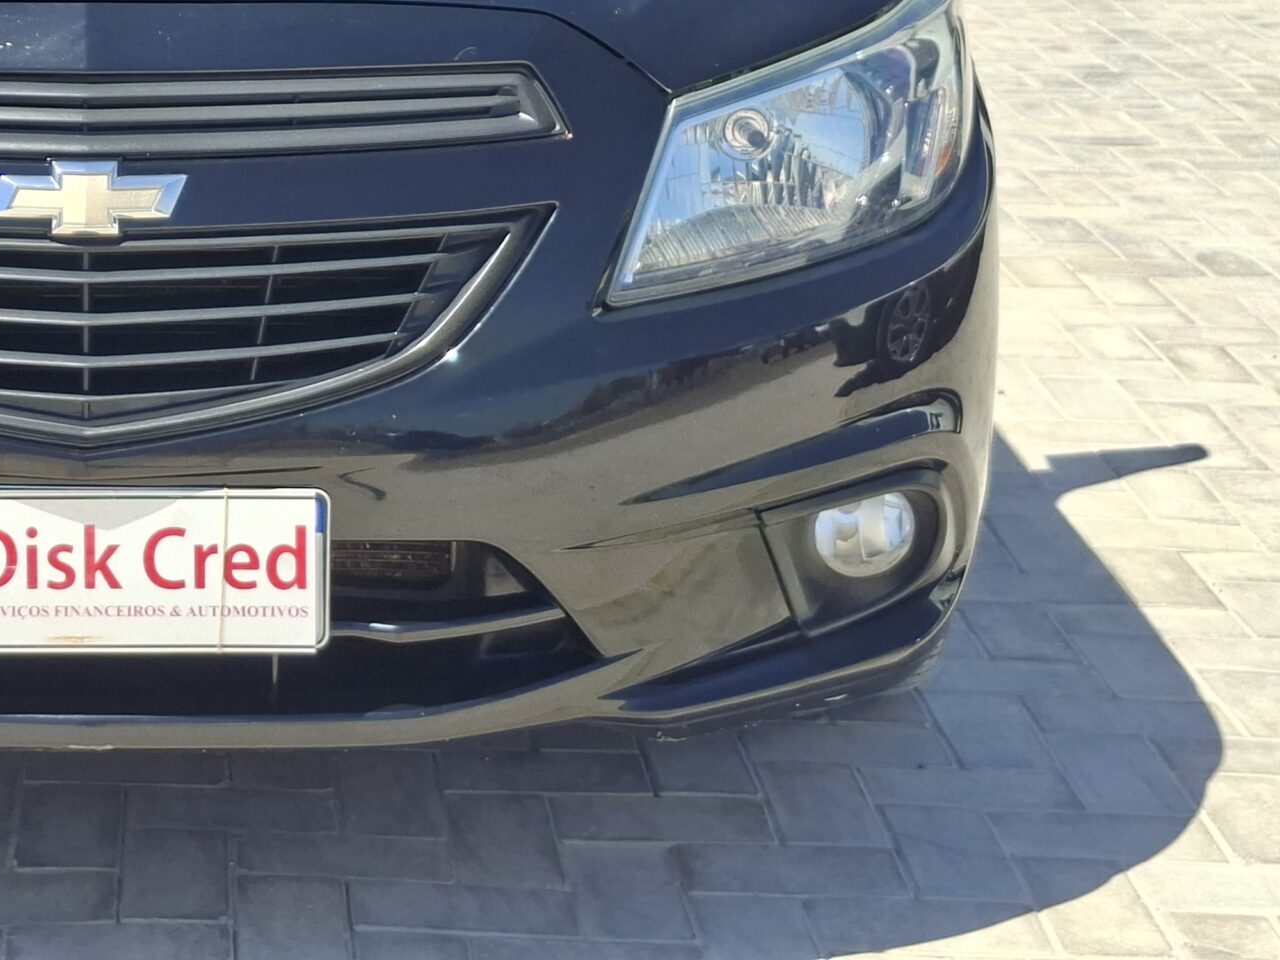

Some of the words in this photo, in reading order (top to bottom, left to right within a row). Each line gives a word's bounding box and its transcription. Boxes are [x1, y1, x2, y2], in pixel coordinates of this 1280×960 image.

[143, 524, 307, 590] Cred
[54, 605, 165, 618] FINANCEIROS
[169, 605, 182, 618] &
[185, 605, 310, 619] AUTOMOTIVOS
